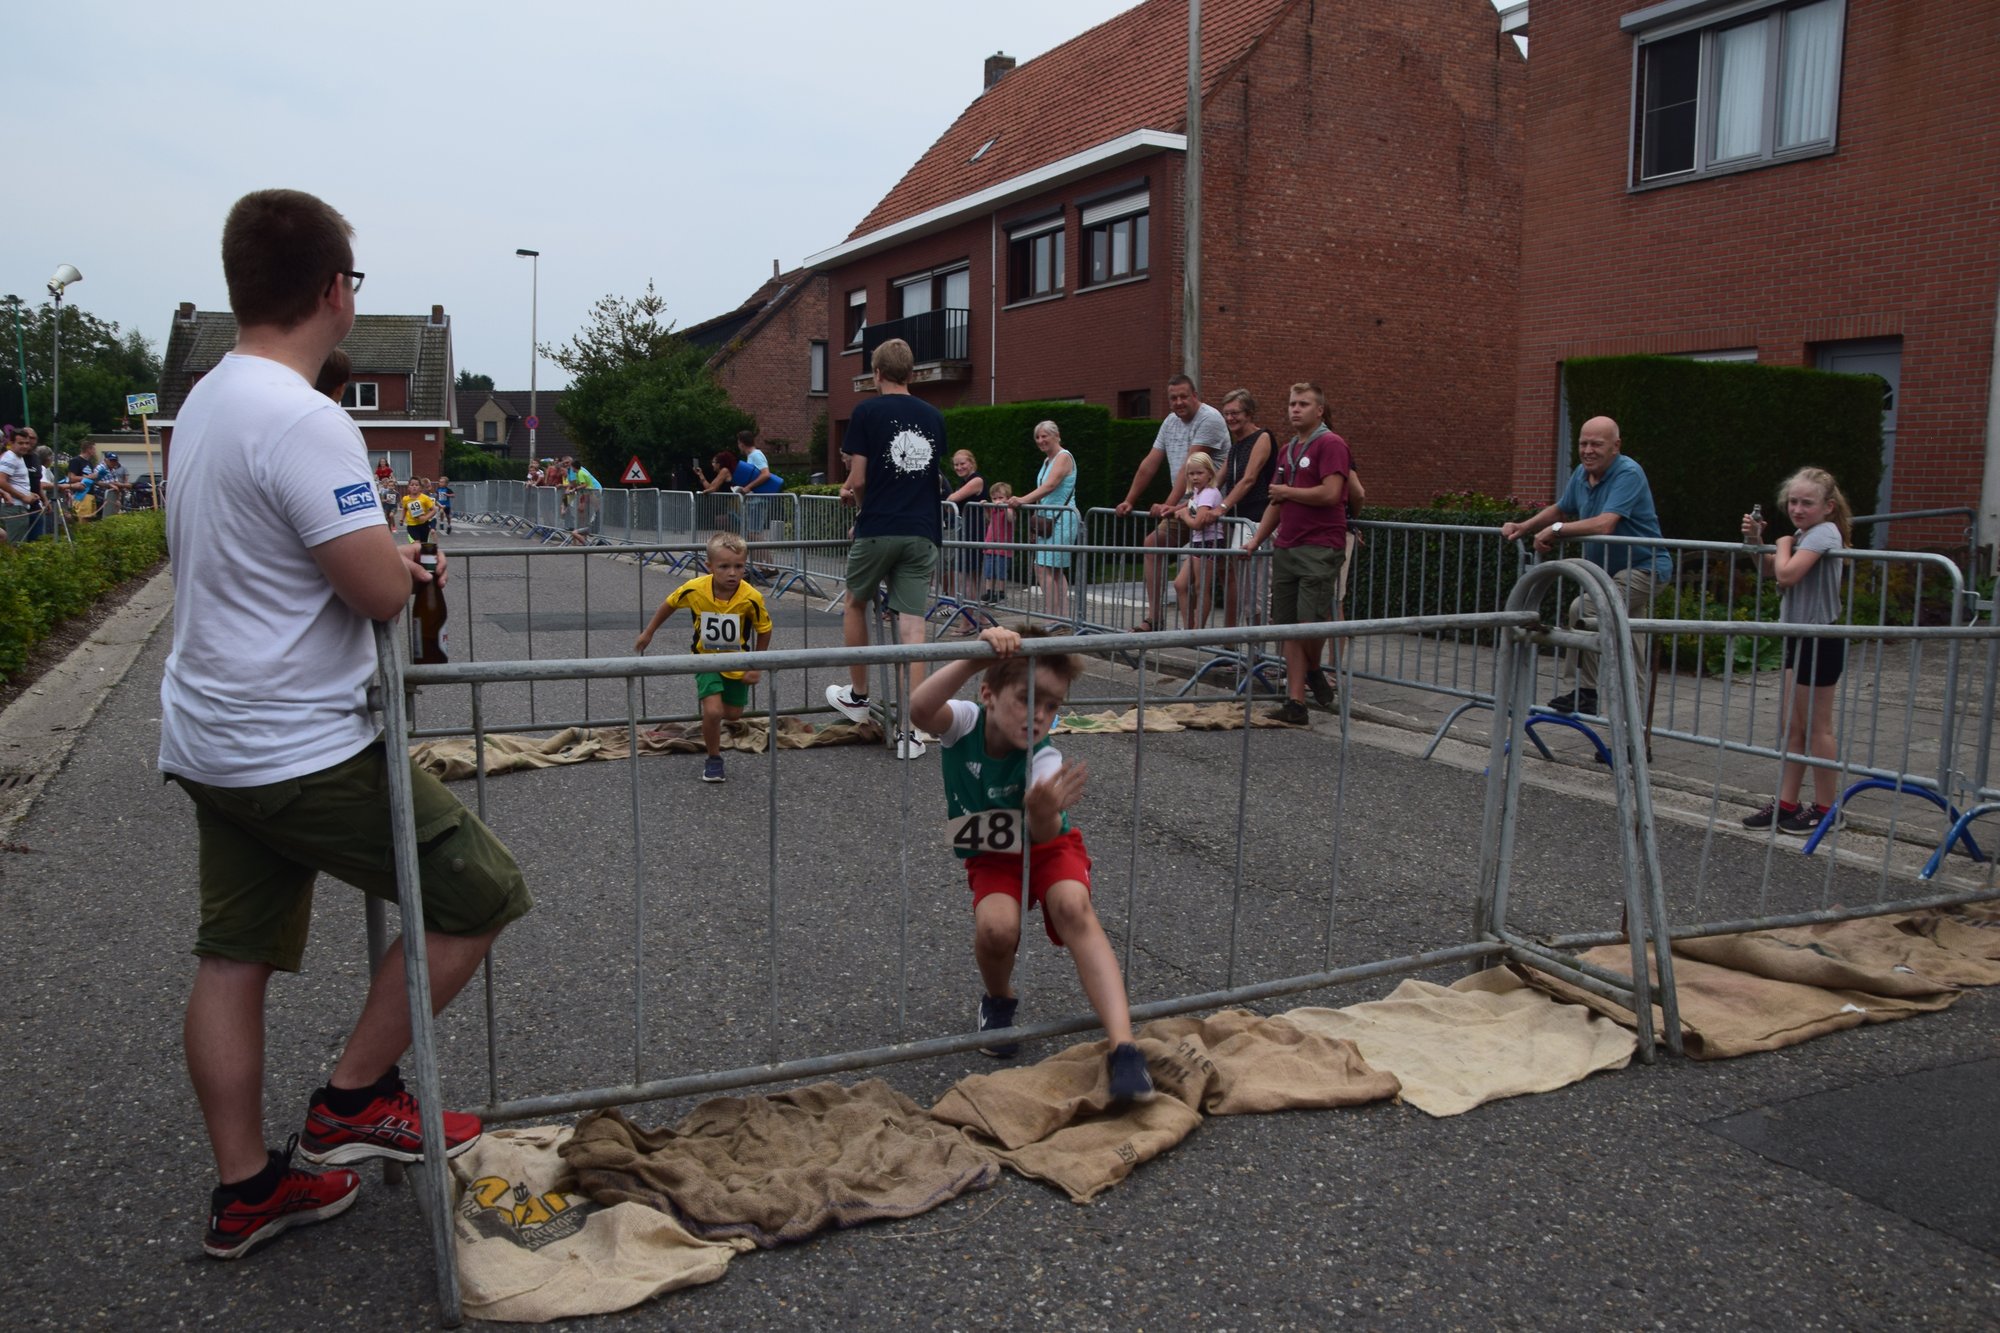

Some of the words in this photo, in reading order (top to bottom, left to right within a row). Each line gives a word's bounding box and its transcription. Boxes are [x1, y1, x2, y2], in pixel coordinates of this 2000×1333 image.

[129, 398, 156, 409] START
[341, 492, 373, 508] NEYS
[410, 501, 421, 511] 49
[705, 617, 736, 643] 50
[953, 812, 1015, 850] 48
